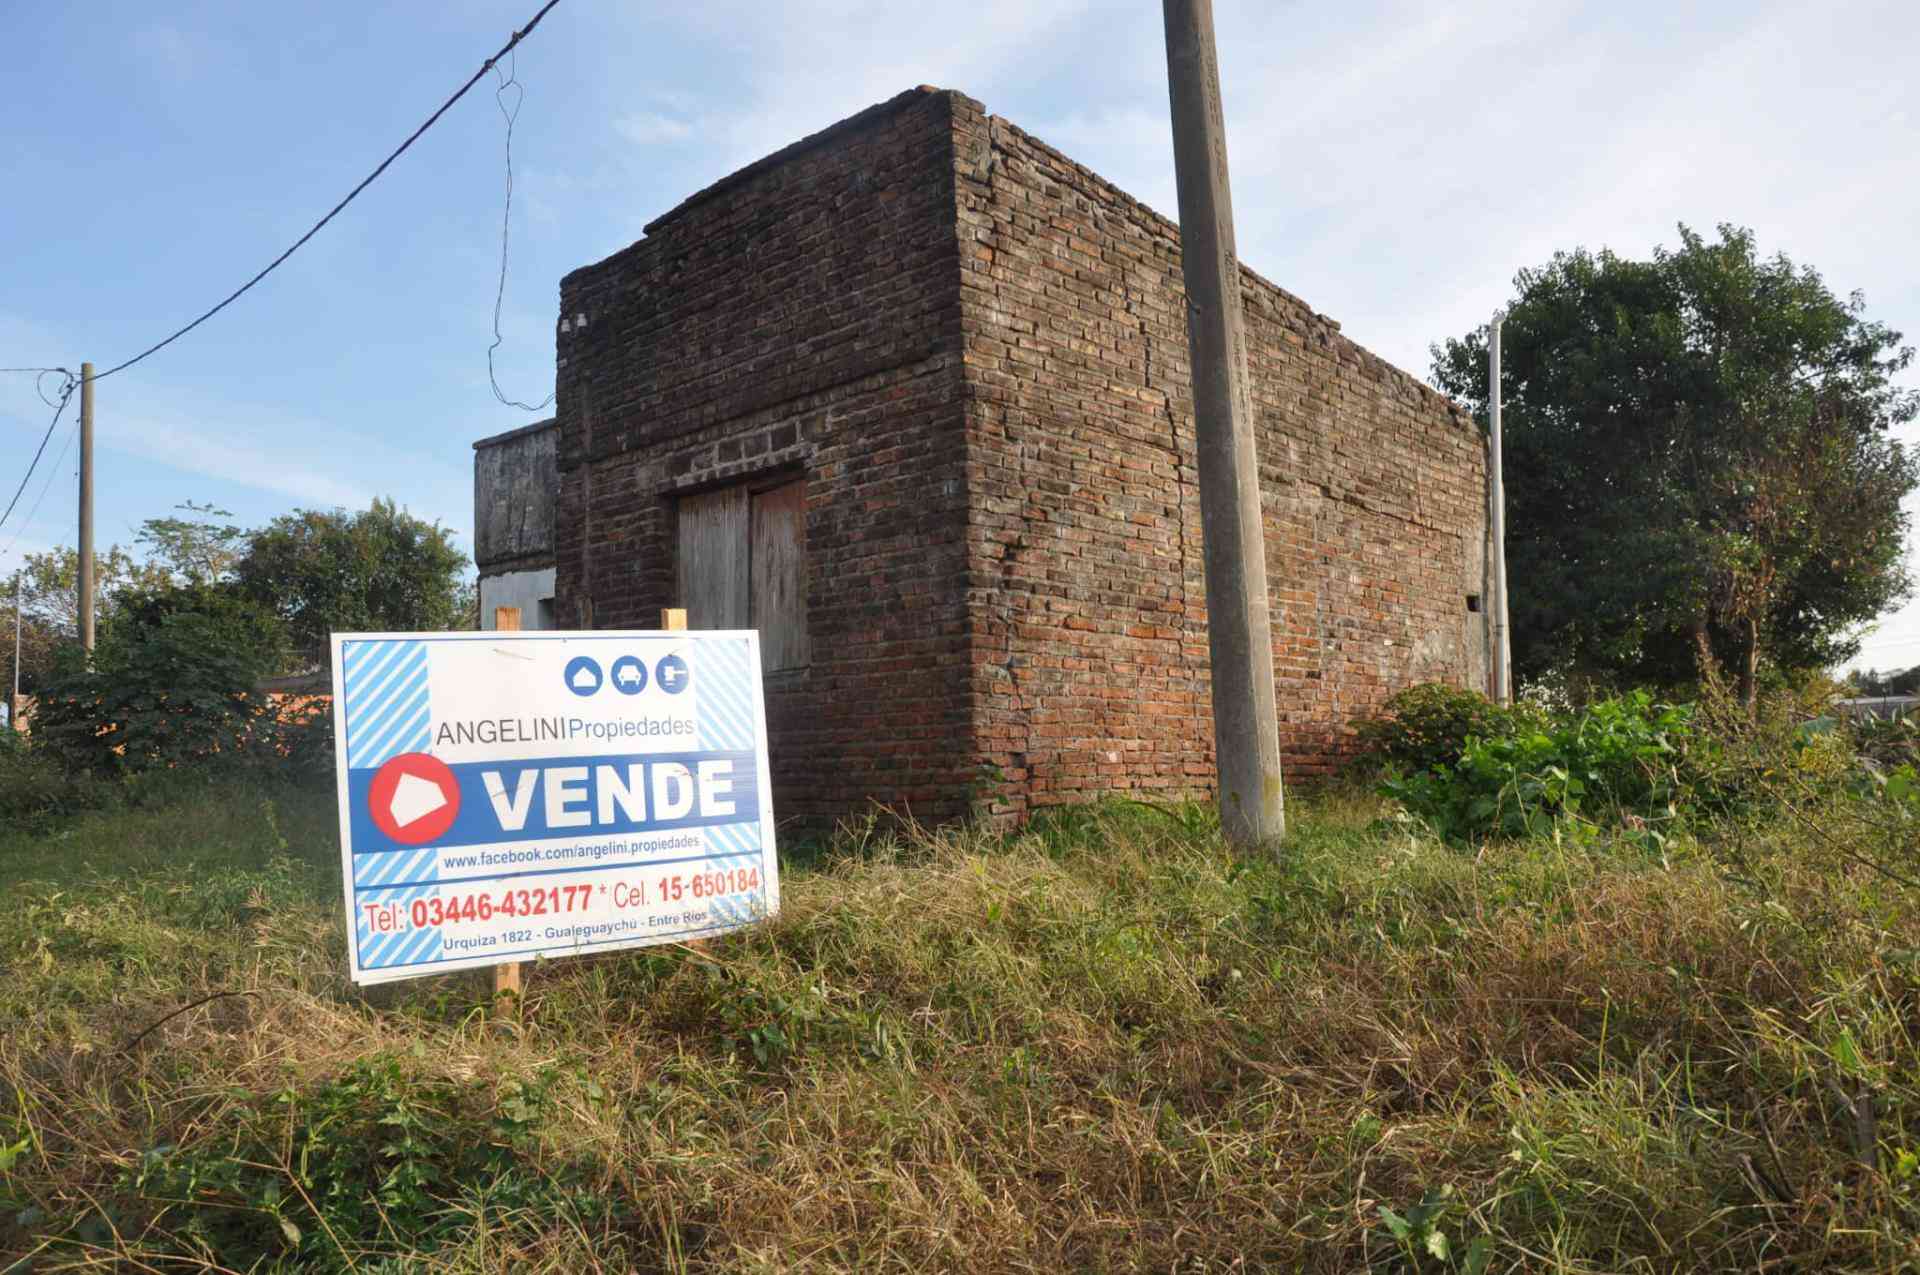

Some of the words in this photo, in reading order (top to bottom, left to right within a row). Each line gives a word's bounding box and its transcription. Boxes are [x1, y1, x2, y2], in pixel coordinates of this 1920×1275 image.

[481, 759, 736, 832] VENDE
[444, 834, 700, 869] www.facebook.com/angelini.propiedades
[364, 902, 404, 932] Tel:
[411, 884, 593, 928] 03446-432177
[613, 880, 650, 909] Cel.
[659, 867, 760, 902] 15-650184
[443, 935, 497, 951] Urquiza
[502, 929, 532, 944] 1822
[648, 912, 680, 927] Entre
